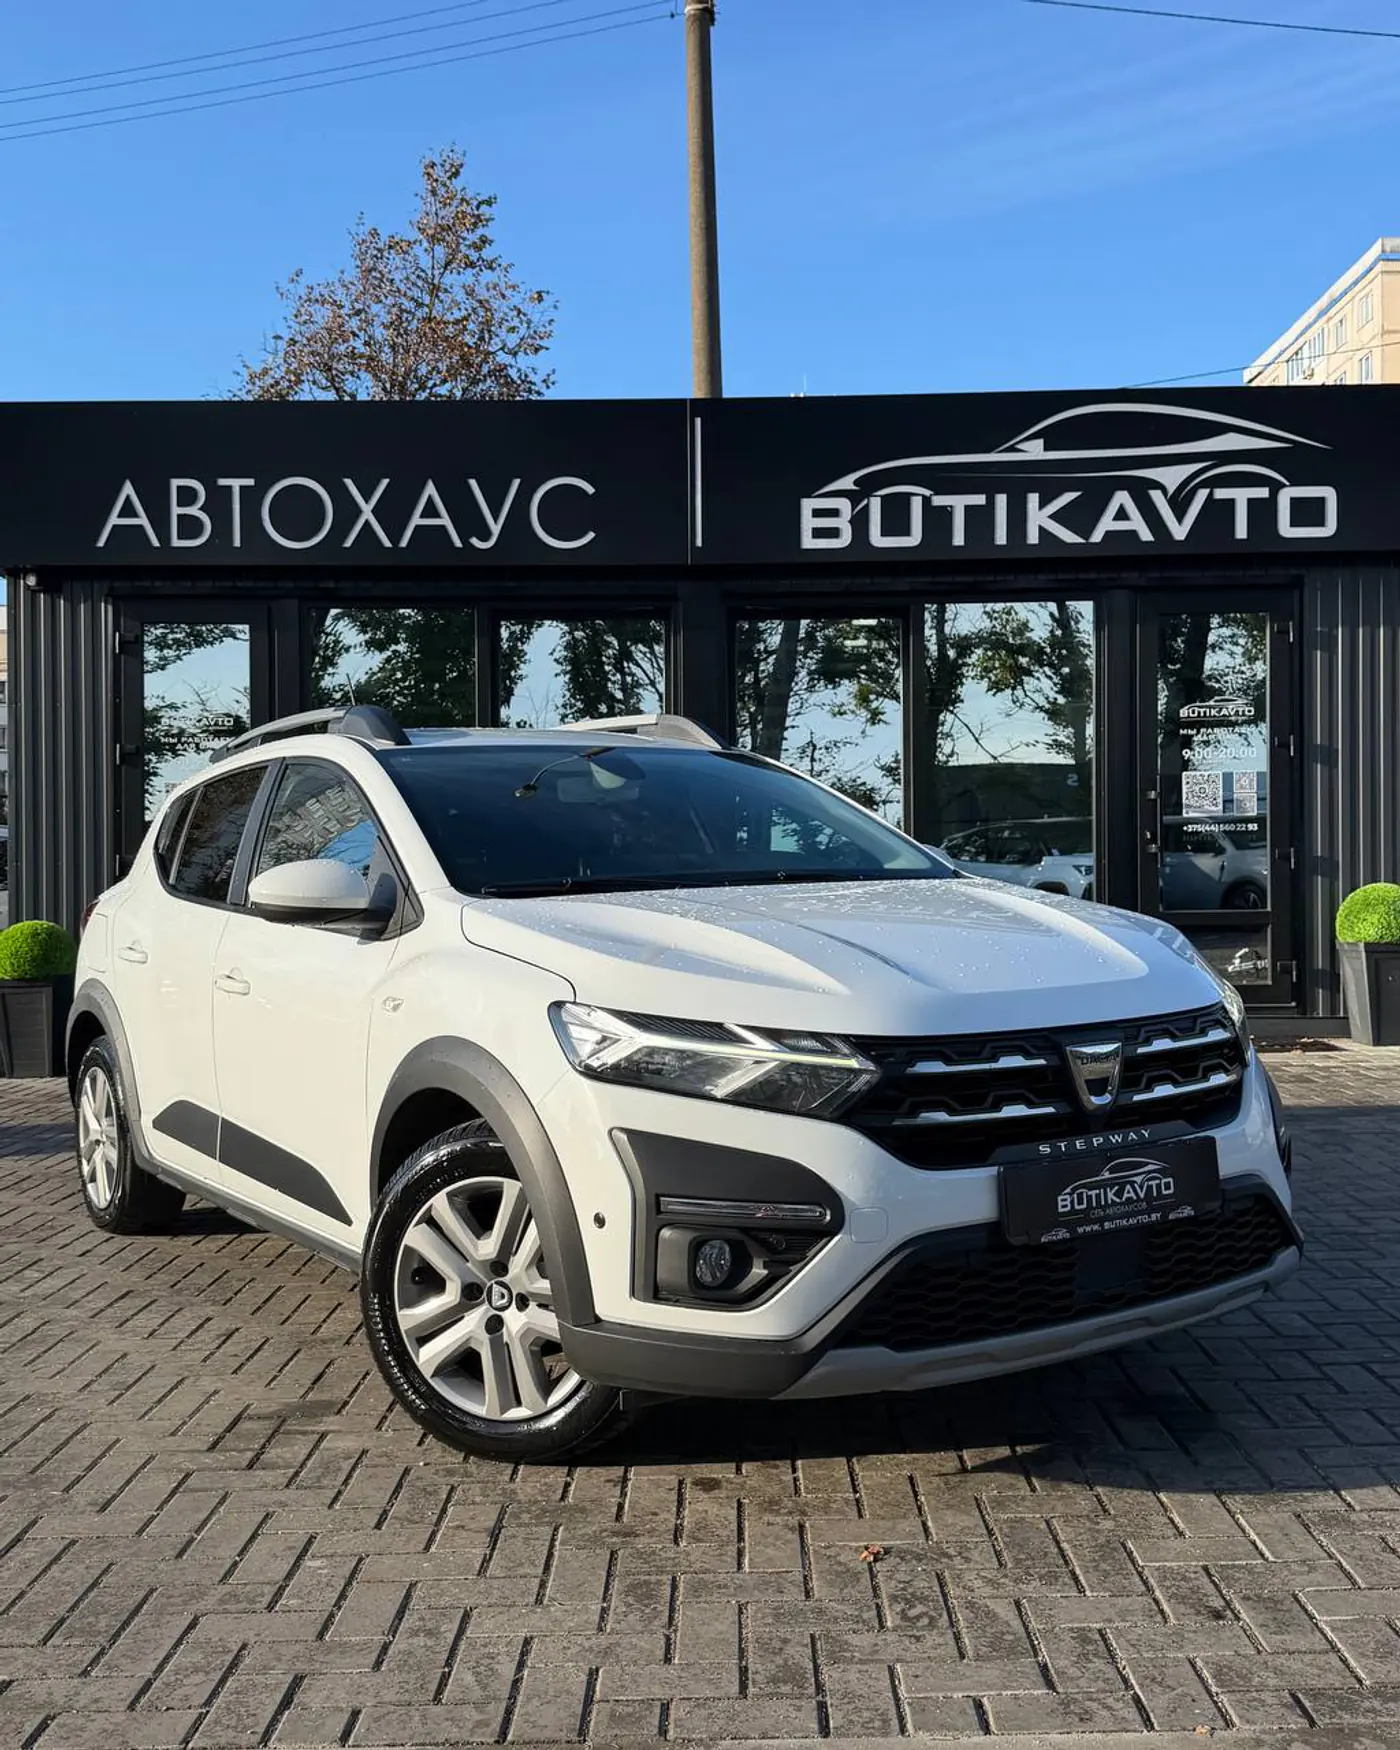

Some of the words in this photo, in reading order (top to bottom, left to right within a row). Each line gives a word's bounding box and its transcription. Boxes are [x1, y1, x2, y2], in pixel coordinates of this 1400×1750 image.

[95, 476, 597, 550] АВТОХАУС
[800, 485, 1339, 550] BUTIKAVTO
[1179, 706, 1255, 718] BUTIKAVTO
[1236, 823, 1246, 832] 22
[1038, 1128, 1152, 1154] STEPWAY
[1057, 1177, 1175, 1213] BUTIKAVTO
